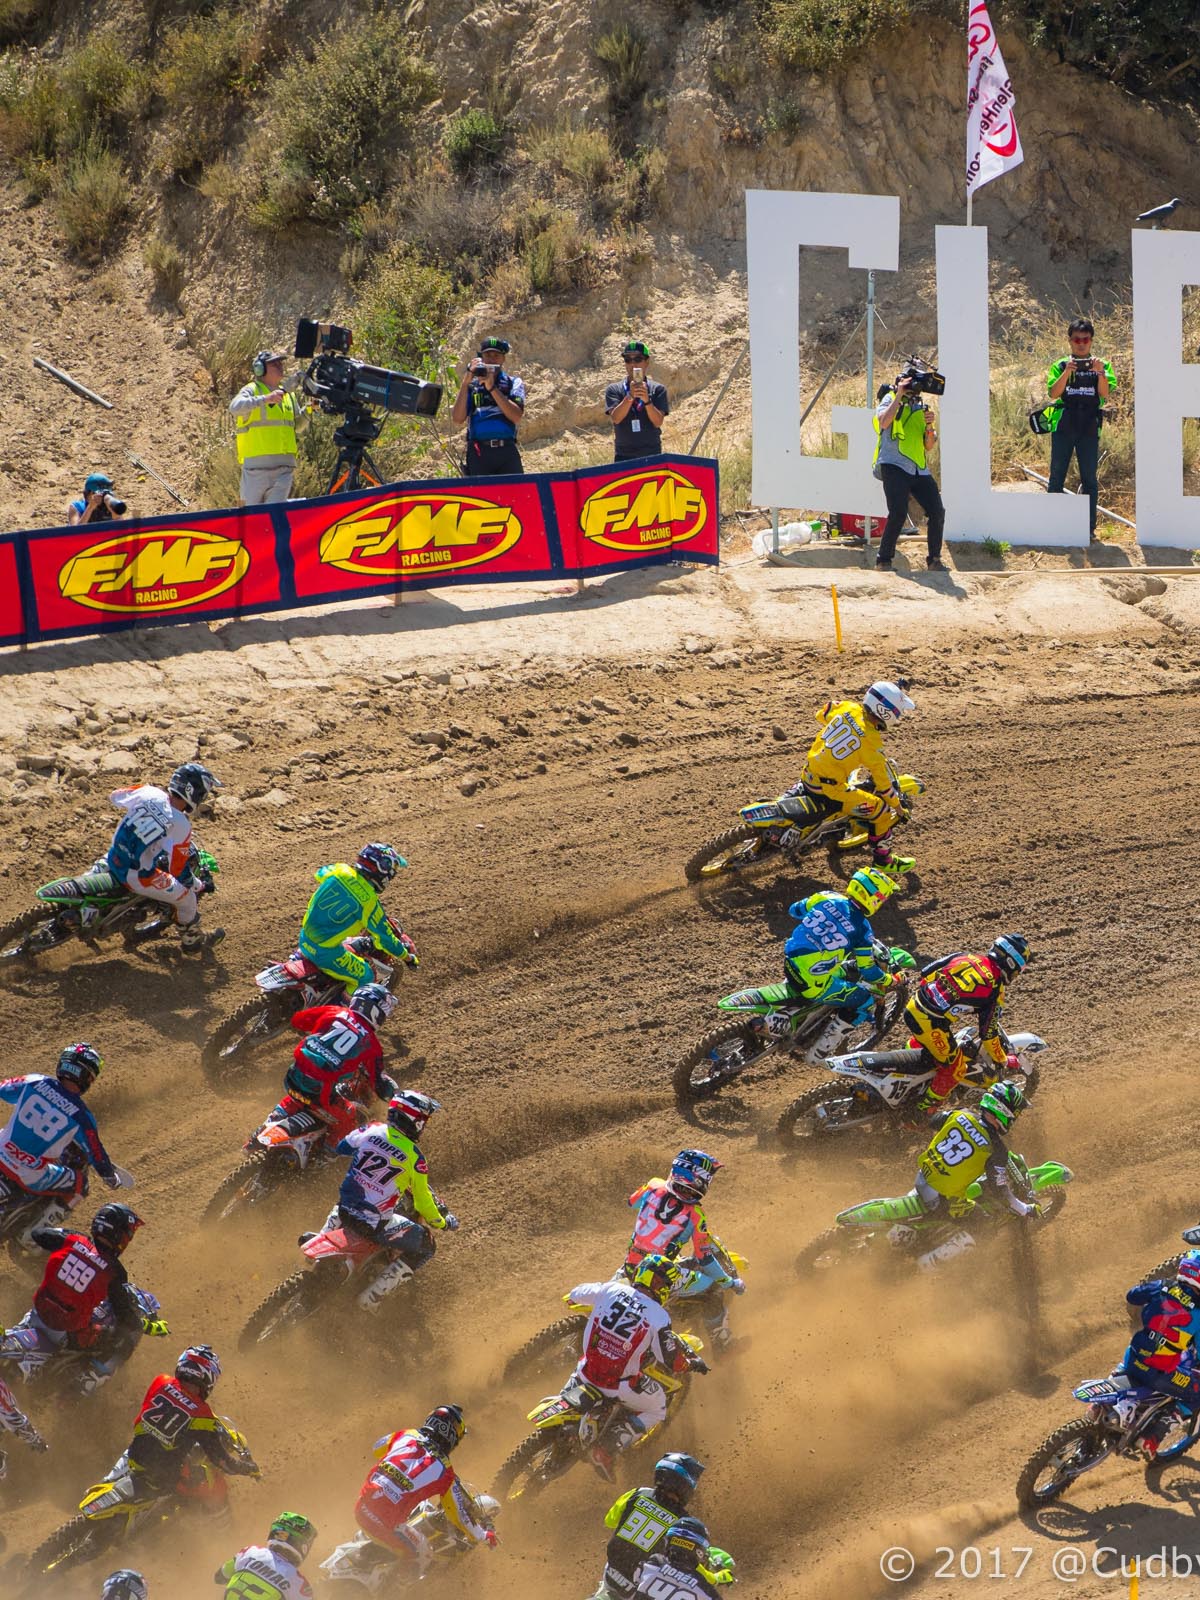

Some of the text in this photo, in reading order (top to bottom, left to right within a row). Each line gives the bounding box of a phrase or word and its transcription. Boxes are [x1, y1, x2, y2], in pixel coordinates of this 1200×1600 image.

[581, 477, 703, 534] FMF
[320, 503, 515, 562] FMF
[639, 526, 672, 544] RACING
[61, 538, 243, 598] FMF
[401, 548, 452, 567] RACING
[135, 586, 179, 605] RACING
[125, 805, 167, 846] 140
[802, 909, 850, 951] 333
[822, 901, 855, 932] CARTER
[950, 961, 987, 994] 15
[320, 1020, 359, 1056] 70
[34, 1080, 80, 1117] HARRISON
[18, 1094, 69, 1142] 68
[956, 1114, 990, 1148] GRANT
[367, 1134, 408, 1163] COOPER
[935, 1126, 975, 1167] 33
[353, 1148, 405, 1187] 121
[355, 1174, 385, 1197] HONDA
[58, 1253, 97, 1293] 559
[600, 1300, 642, 1340] 32
[163, 1383, 198, 1411] TICKLE
[636, 1498, 678, 1526] EPSTEIN
[244, 1556, 291, 1592] TOMAC
